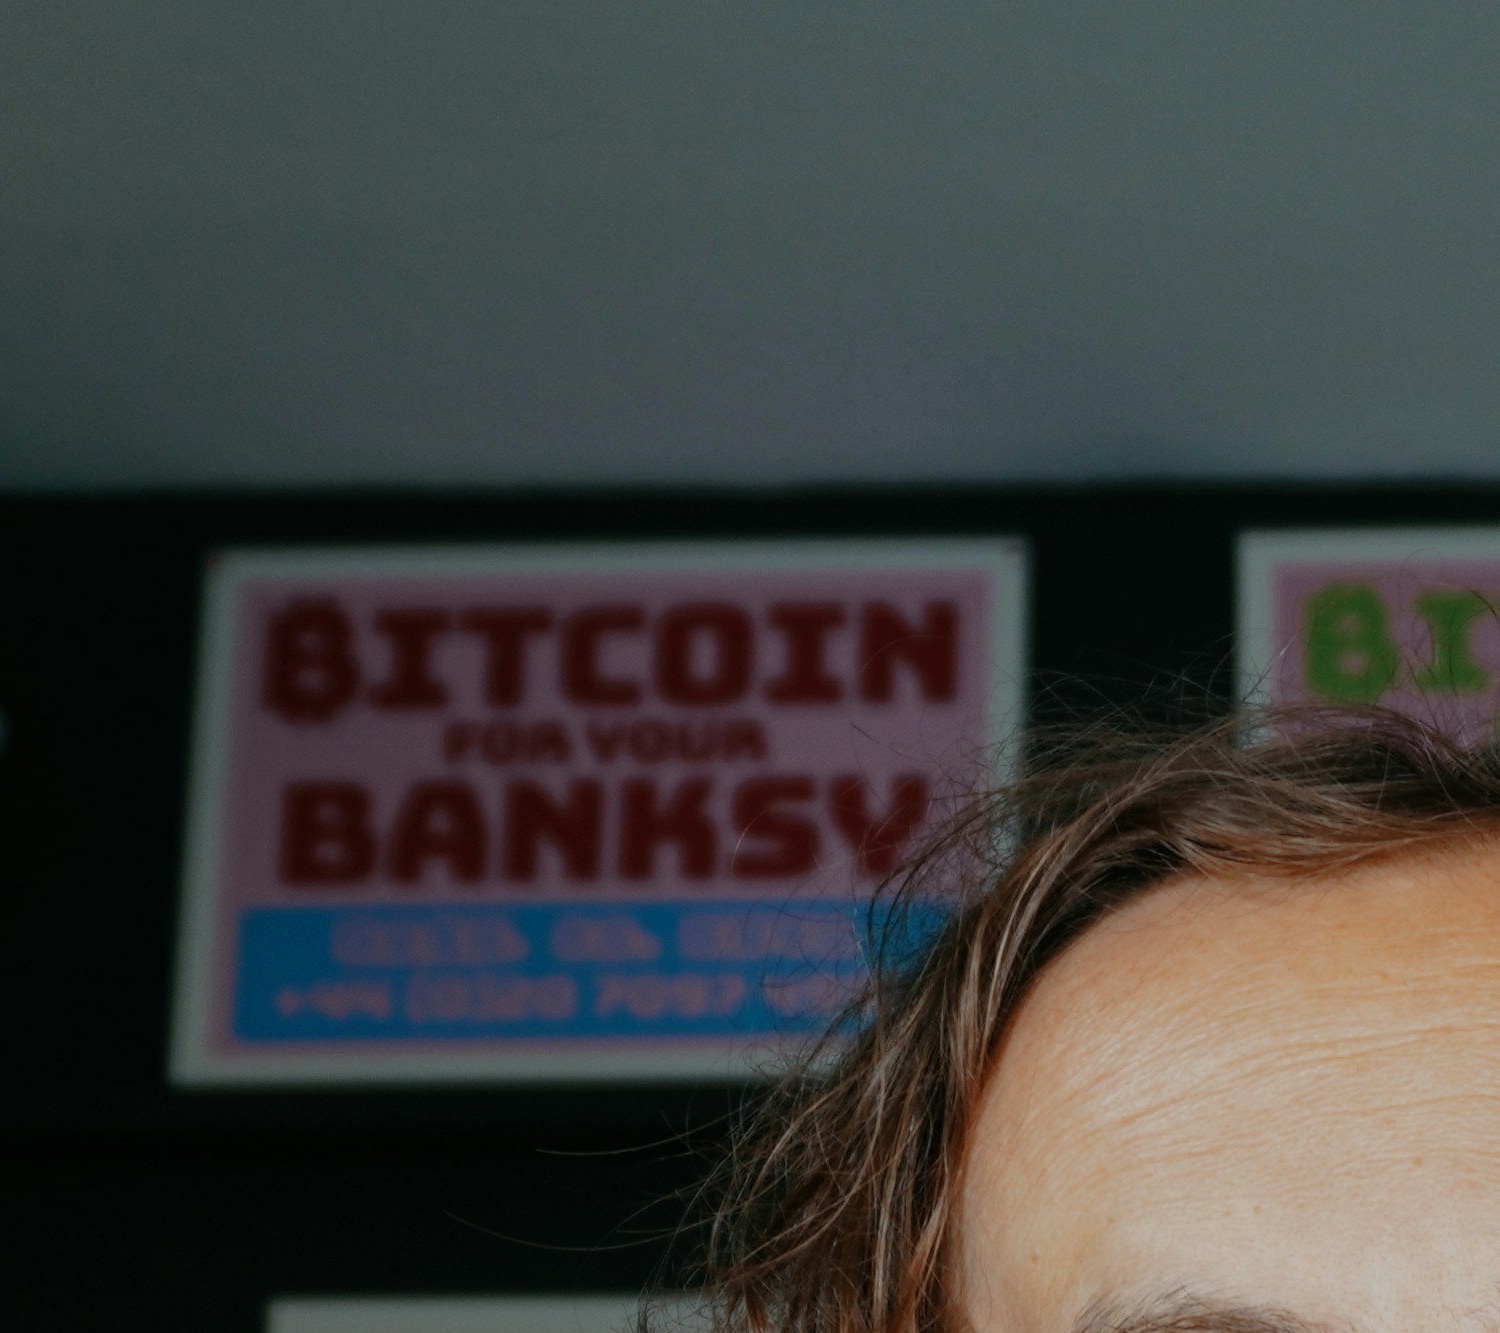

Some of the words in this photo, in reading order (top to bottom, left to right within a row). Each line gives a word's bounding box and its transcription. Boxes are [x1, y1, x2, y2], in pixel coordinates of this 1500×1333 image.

[444, 722, 573, 767] FOR
[588, 717, 766, 763] YOUR
[280, 776, 932, 888] BANKSY
